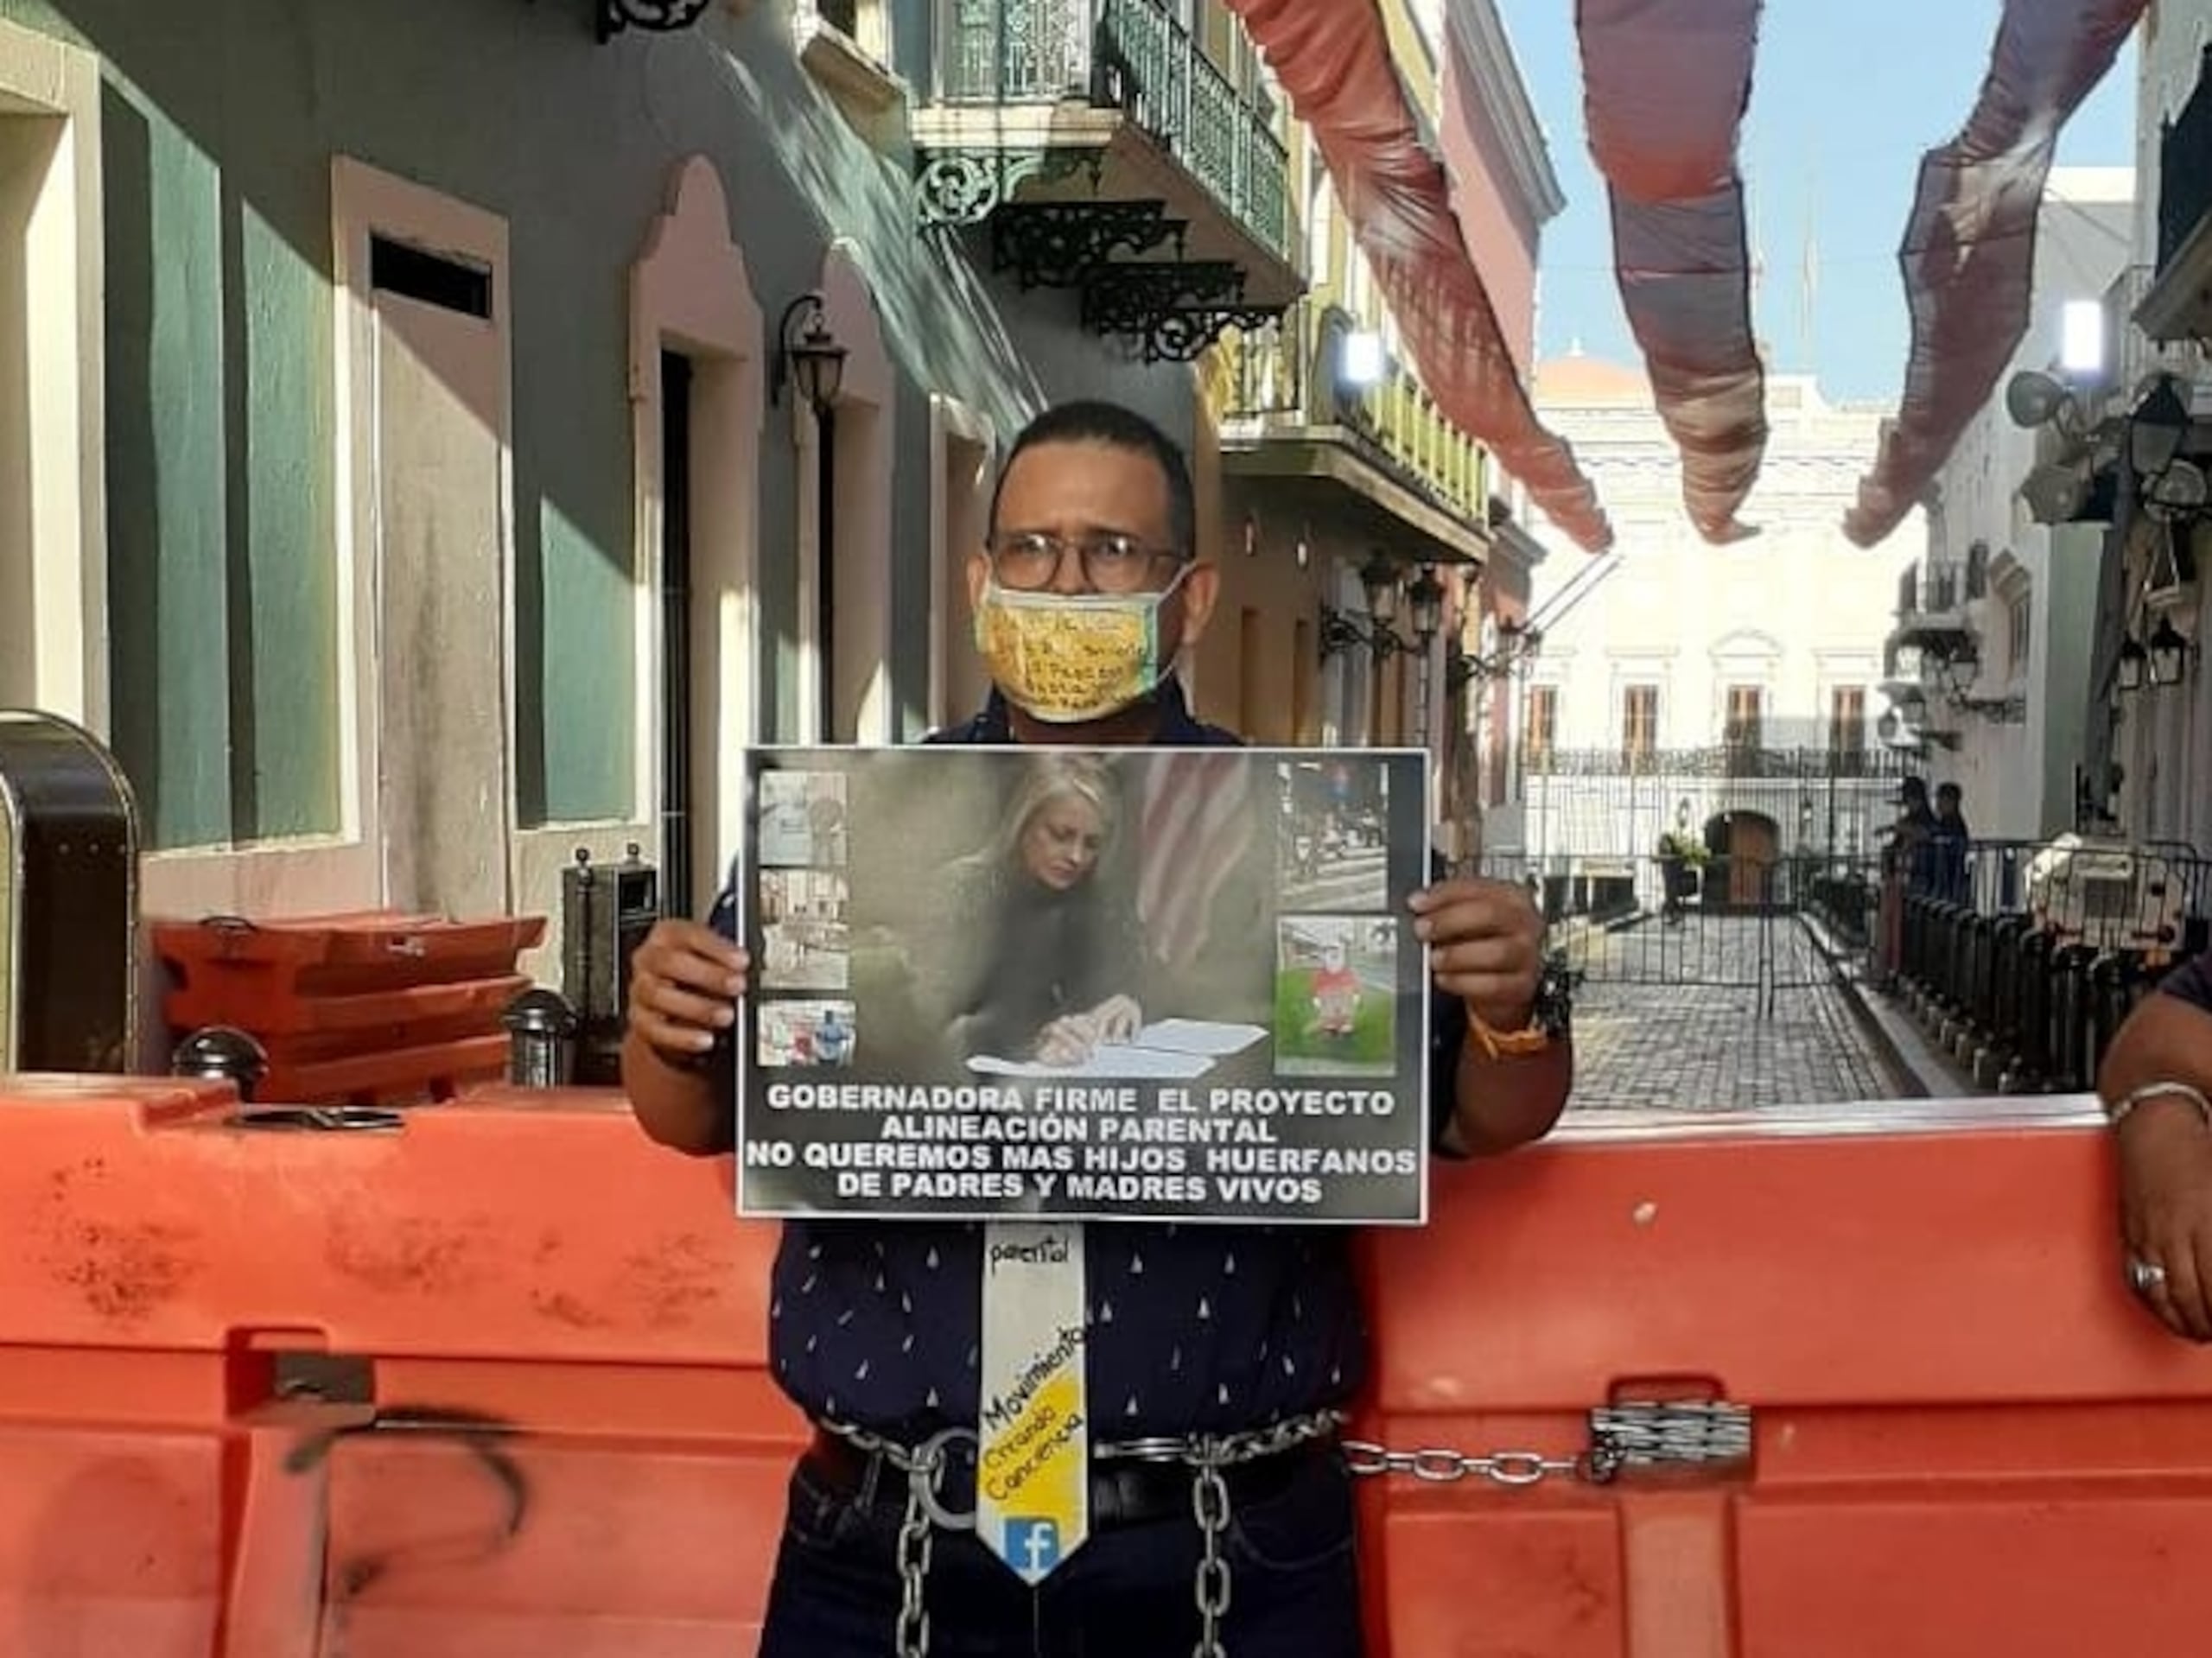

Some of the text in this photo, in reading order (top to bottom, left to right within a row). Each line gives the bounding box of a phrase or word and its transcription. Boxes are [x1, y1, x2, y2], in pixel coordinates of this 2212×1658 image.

[767, 1084, 1395, 1115] GOBERNADORA FIRME EL PROYECTO
[881, 1112, 1277, 1143] ALINEACIÓN PARENTAL
[747, 1141, 1416, 1174] NO QUEREMOS MAS HIJOS HUERFANOS
[837, 1172, 1322, 1204] DE PADRES Y MADRES VIVOS
